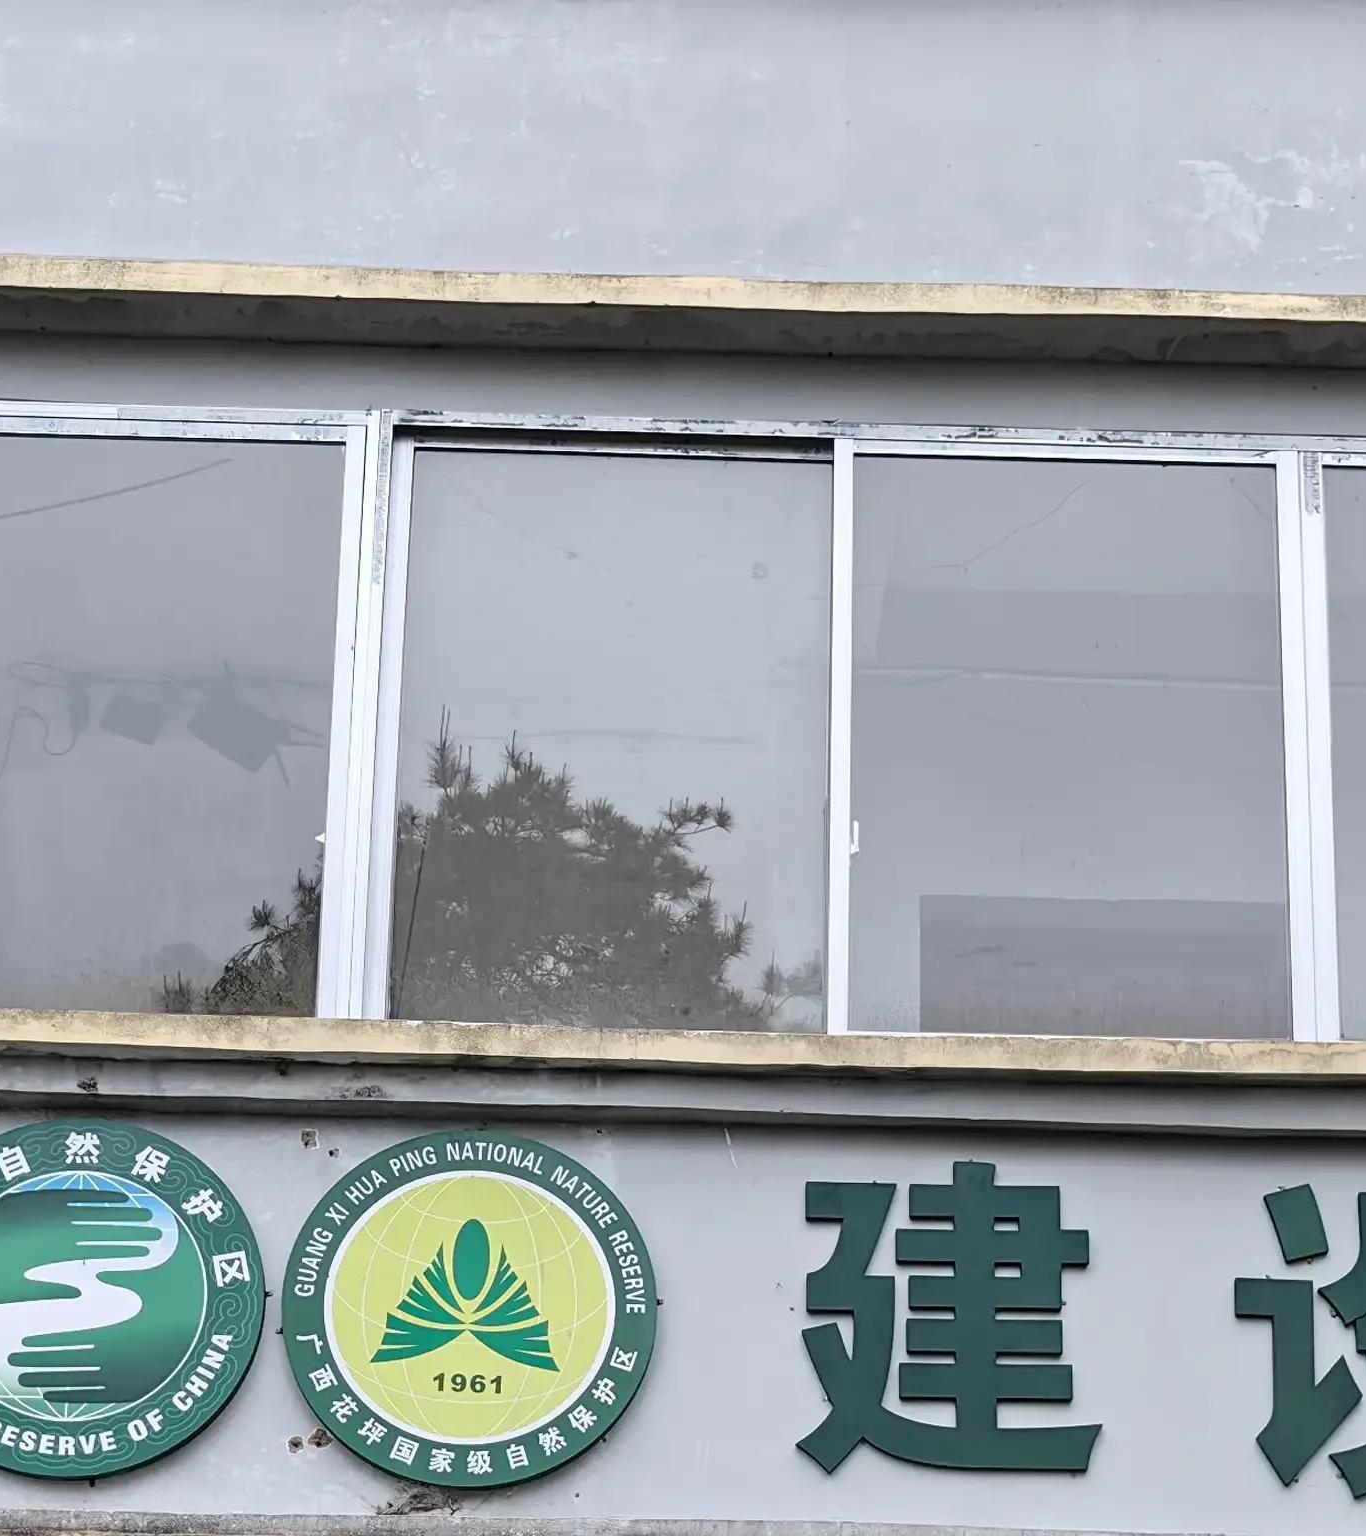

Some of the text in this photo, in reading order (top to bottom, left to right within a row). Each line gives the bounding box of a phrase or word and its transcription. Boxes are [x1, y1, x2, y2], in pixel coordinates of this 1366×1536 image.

[294, 1142, 646, 1314] GUANG XI HUA PING NATIONAL NATURE RESERVE
[127, 1408, 164, 1442] OF
[172, 1333, 233, 1411] CHINA
[295, 1332, 639, 1476] 广西花坪国家级自然保护区
[432, 1372, 503, 1394] 1961
